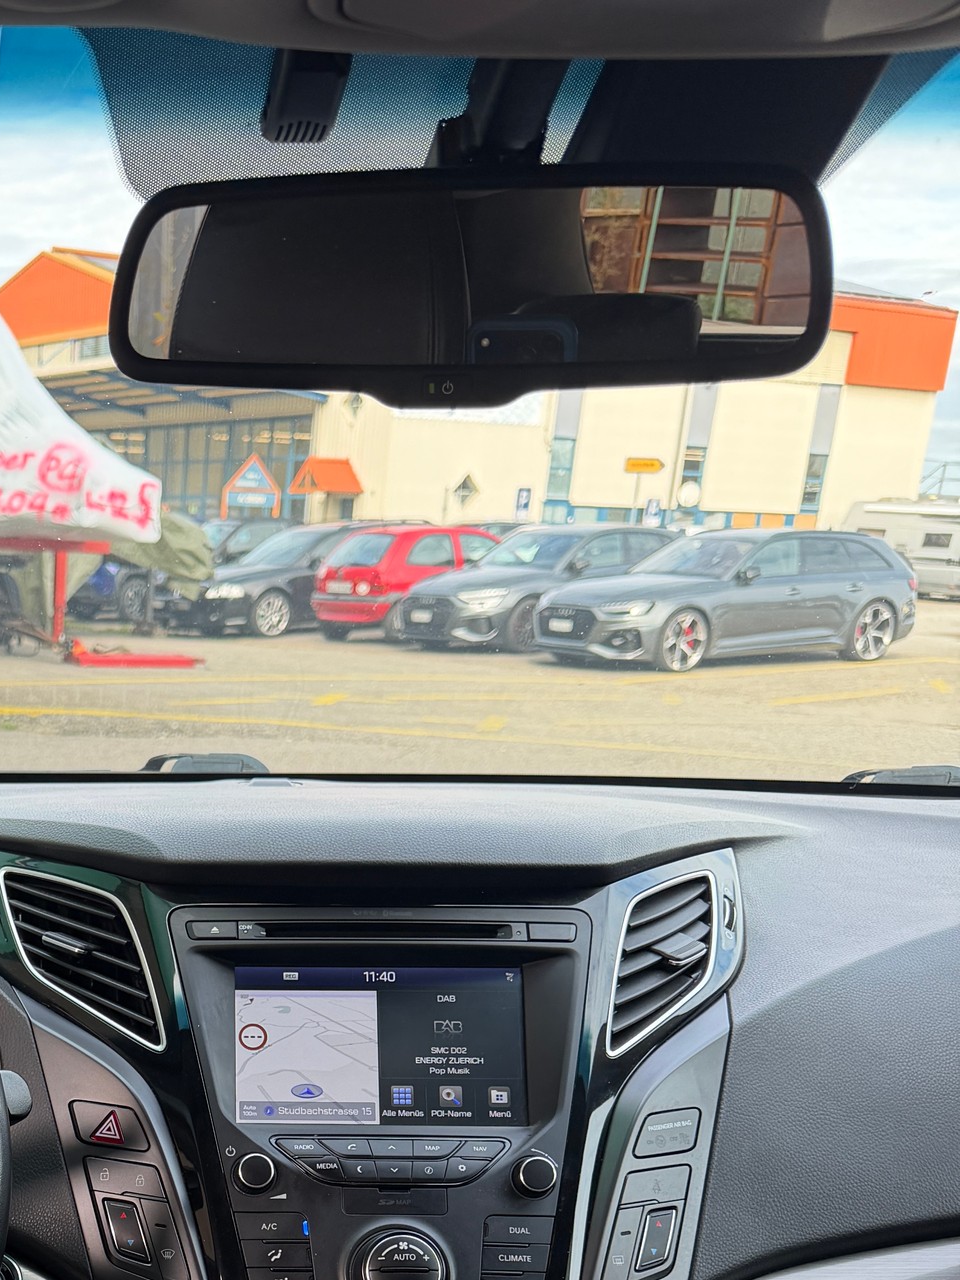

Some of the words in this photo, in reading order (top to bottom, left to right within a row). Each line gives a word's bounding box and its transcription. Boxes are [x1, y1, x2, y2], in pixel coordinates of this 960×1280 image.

[363, 971, 396, 982] 11:40
[437, 995, 456, 1003] DAB
[433, 1019, 463, 1034] DAB
[415, 1057, 447, 1065] ENERGY
[448, 1057, 484, 1065] ZUERICH
[429, 1067, 446, 1076] Pop
[447, 1067, 470, 1075] Musik
[278, 1107, 359, 1116] Studbachstrasse
[361, 1107, 372, 1115] 15
[381, 1109, 397, 1117] Alle
[397, 1109, 424, 1117] Menüs
[431, 1109, 472, 1118] POI-Name
[489, 1110, 512, 1118] Menü
[316, 1162, 338, 1170] MEDIA
[261, 1223, 278, 1231] A/C
[509, 1227, 531, 1235] DUAL
[392, 1253, 417, 1262] AUTO
[498, 1254, 532, 1263] CLIMATE
